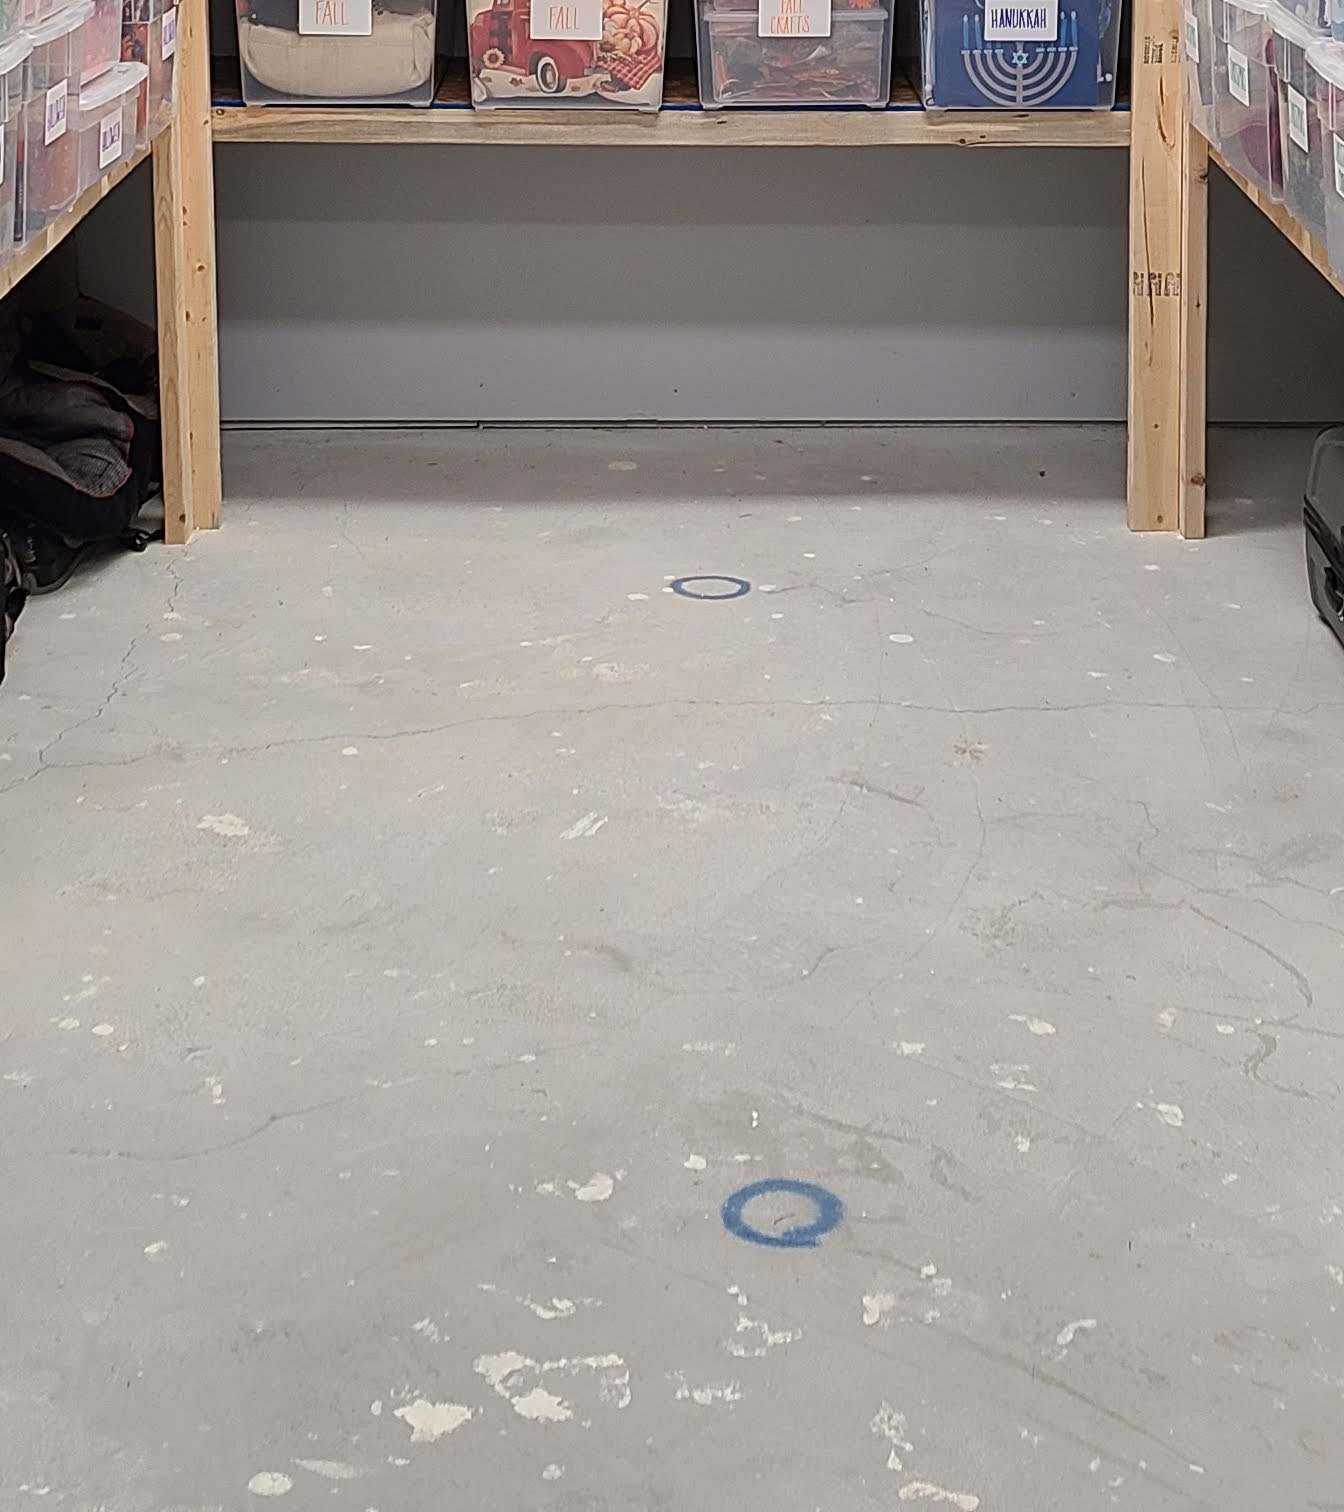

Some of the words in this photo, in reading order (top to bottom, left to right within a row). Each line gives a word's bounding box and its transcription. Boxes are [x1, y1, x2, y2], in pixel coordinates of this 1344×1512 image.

[315, 2, 349, 25] FALL
[549, 6, 582, 30] FALL
[770, 15, 809, 33] CRAFTS
[991, 7, 1046, 30] HANUKKAH
